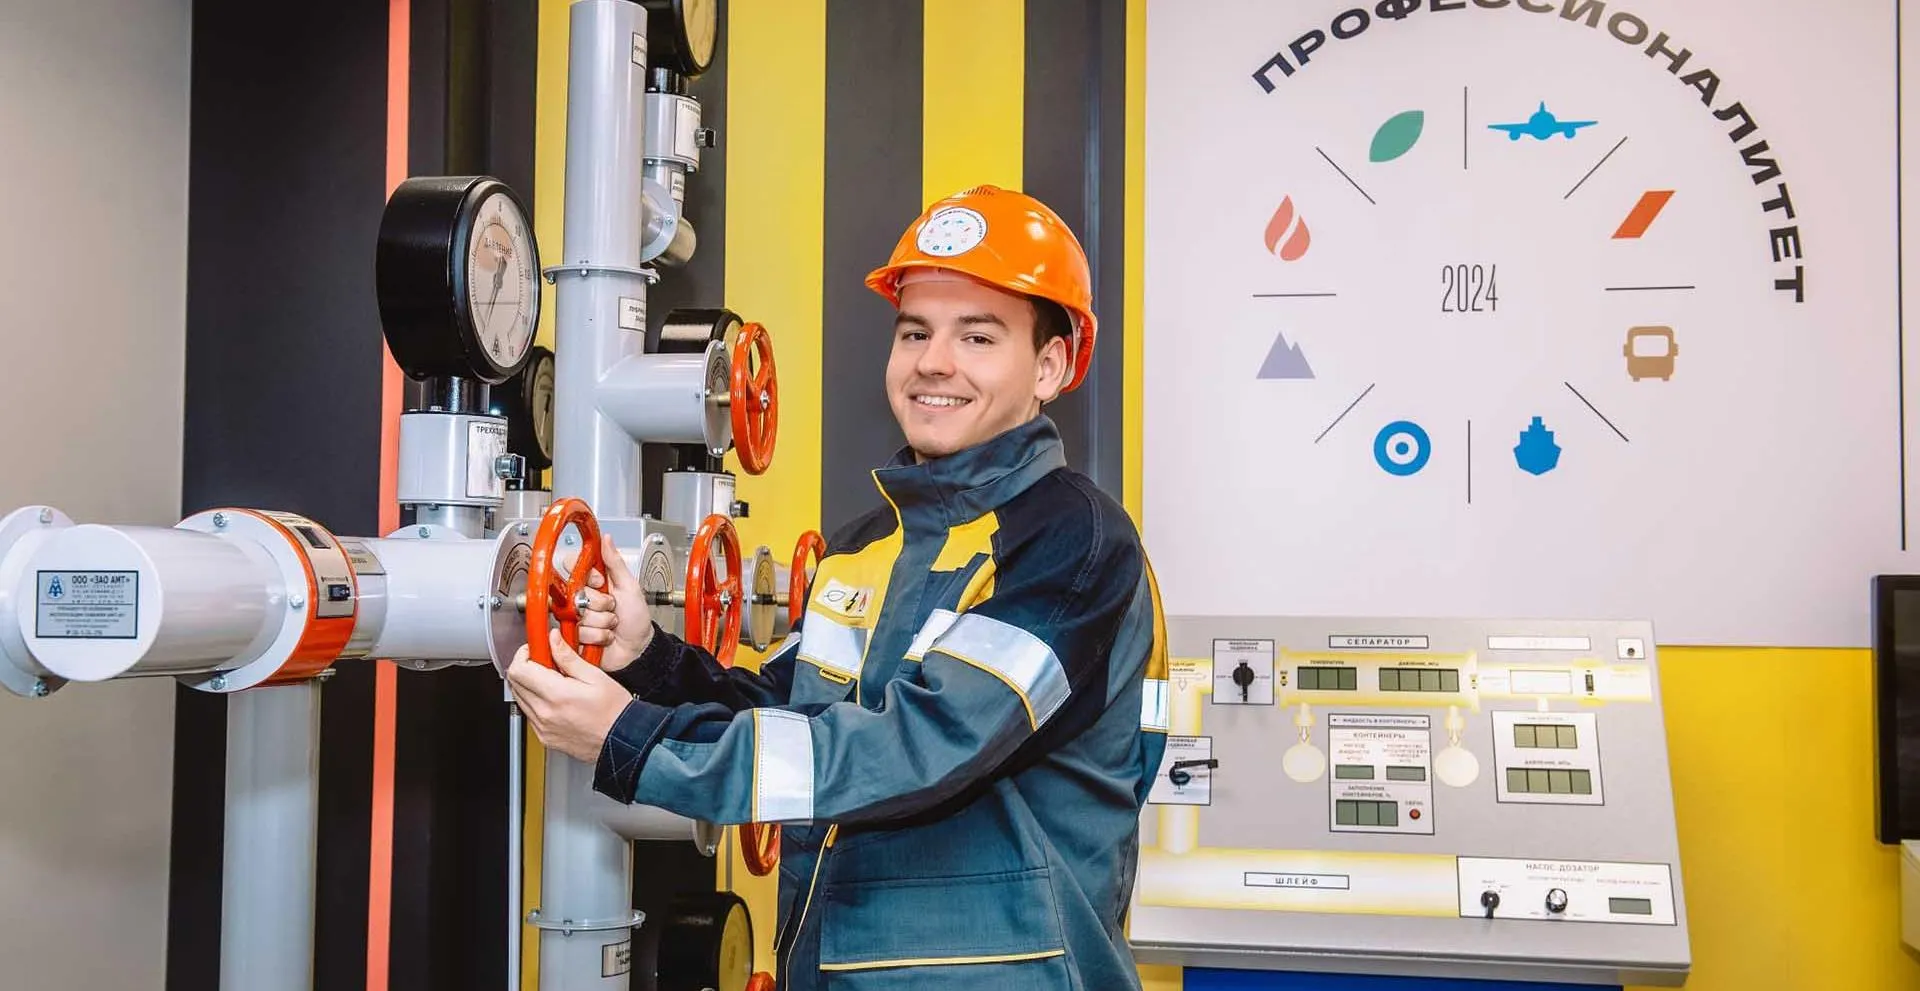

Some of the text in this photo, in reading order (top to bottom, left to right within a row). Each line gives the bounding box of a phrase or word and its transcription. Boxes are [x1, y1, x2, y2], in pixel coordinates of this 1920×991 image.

[1442, 264, 1498, 312] 2024
[72, 575, 88, 584] ООО
[1347, 638, 1411, 647] СЕПАРАТОР
[1353, 732, 1406, 740] КОНТЕЙНЕРЫ
[1275, 876, 1319, 886] ШЛЕЙФ
